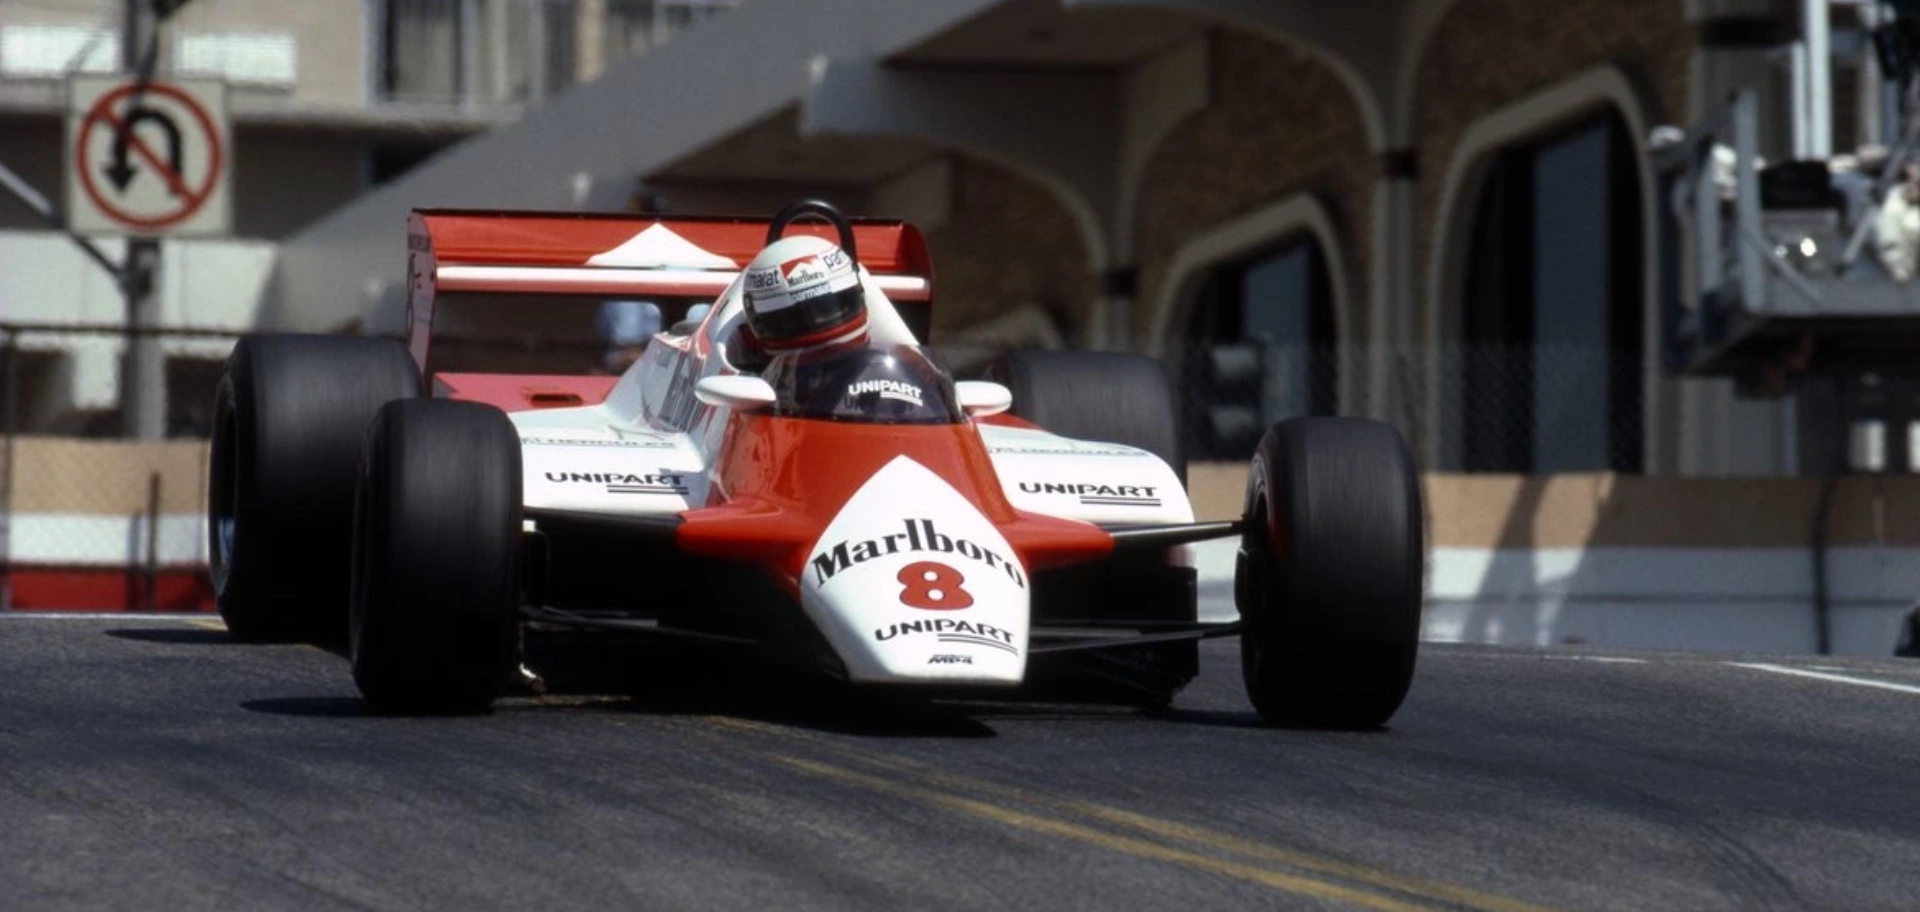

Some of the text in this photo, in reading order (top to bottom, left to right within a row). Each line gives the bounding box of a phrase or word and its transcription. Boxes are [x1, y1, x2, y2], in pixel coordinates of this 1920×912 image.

[786, 268, 824, 288] Marlboro
[848, 380, 922, 397] UNIPART
[545, 472, 684, 485] UNIPART
[1019, 482, 1157, 497] UNIPART
[812, 518, 1025, 588] Marlboro
[897, 561, 974, 611] 8
[875, 619, 1014, 643] UNIPART
